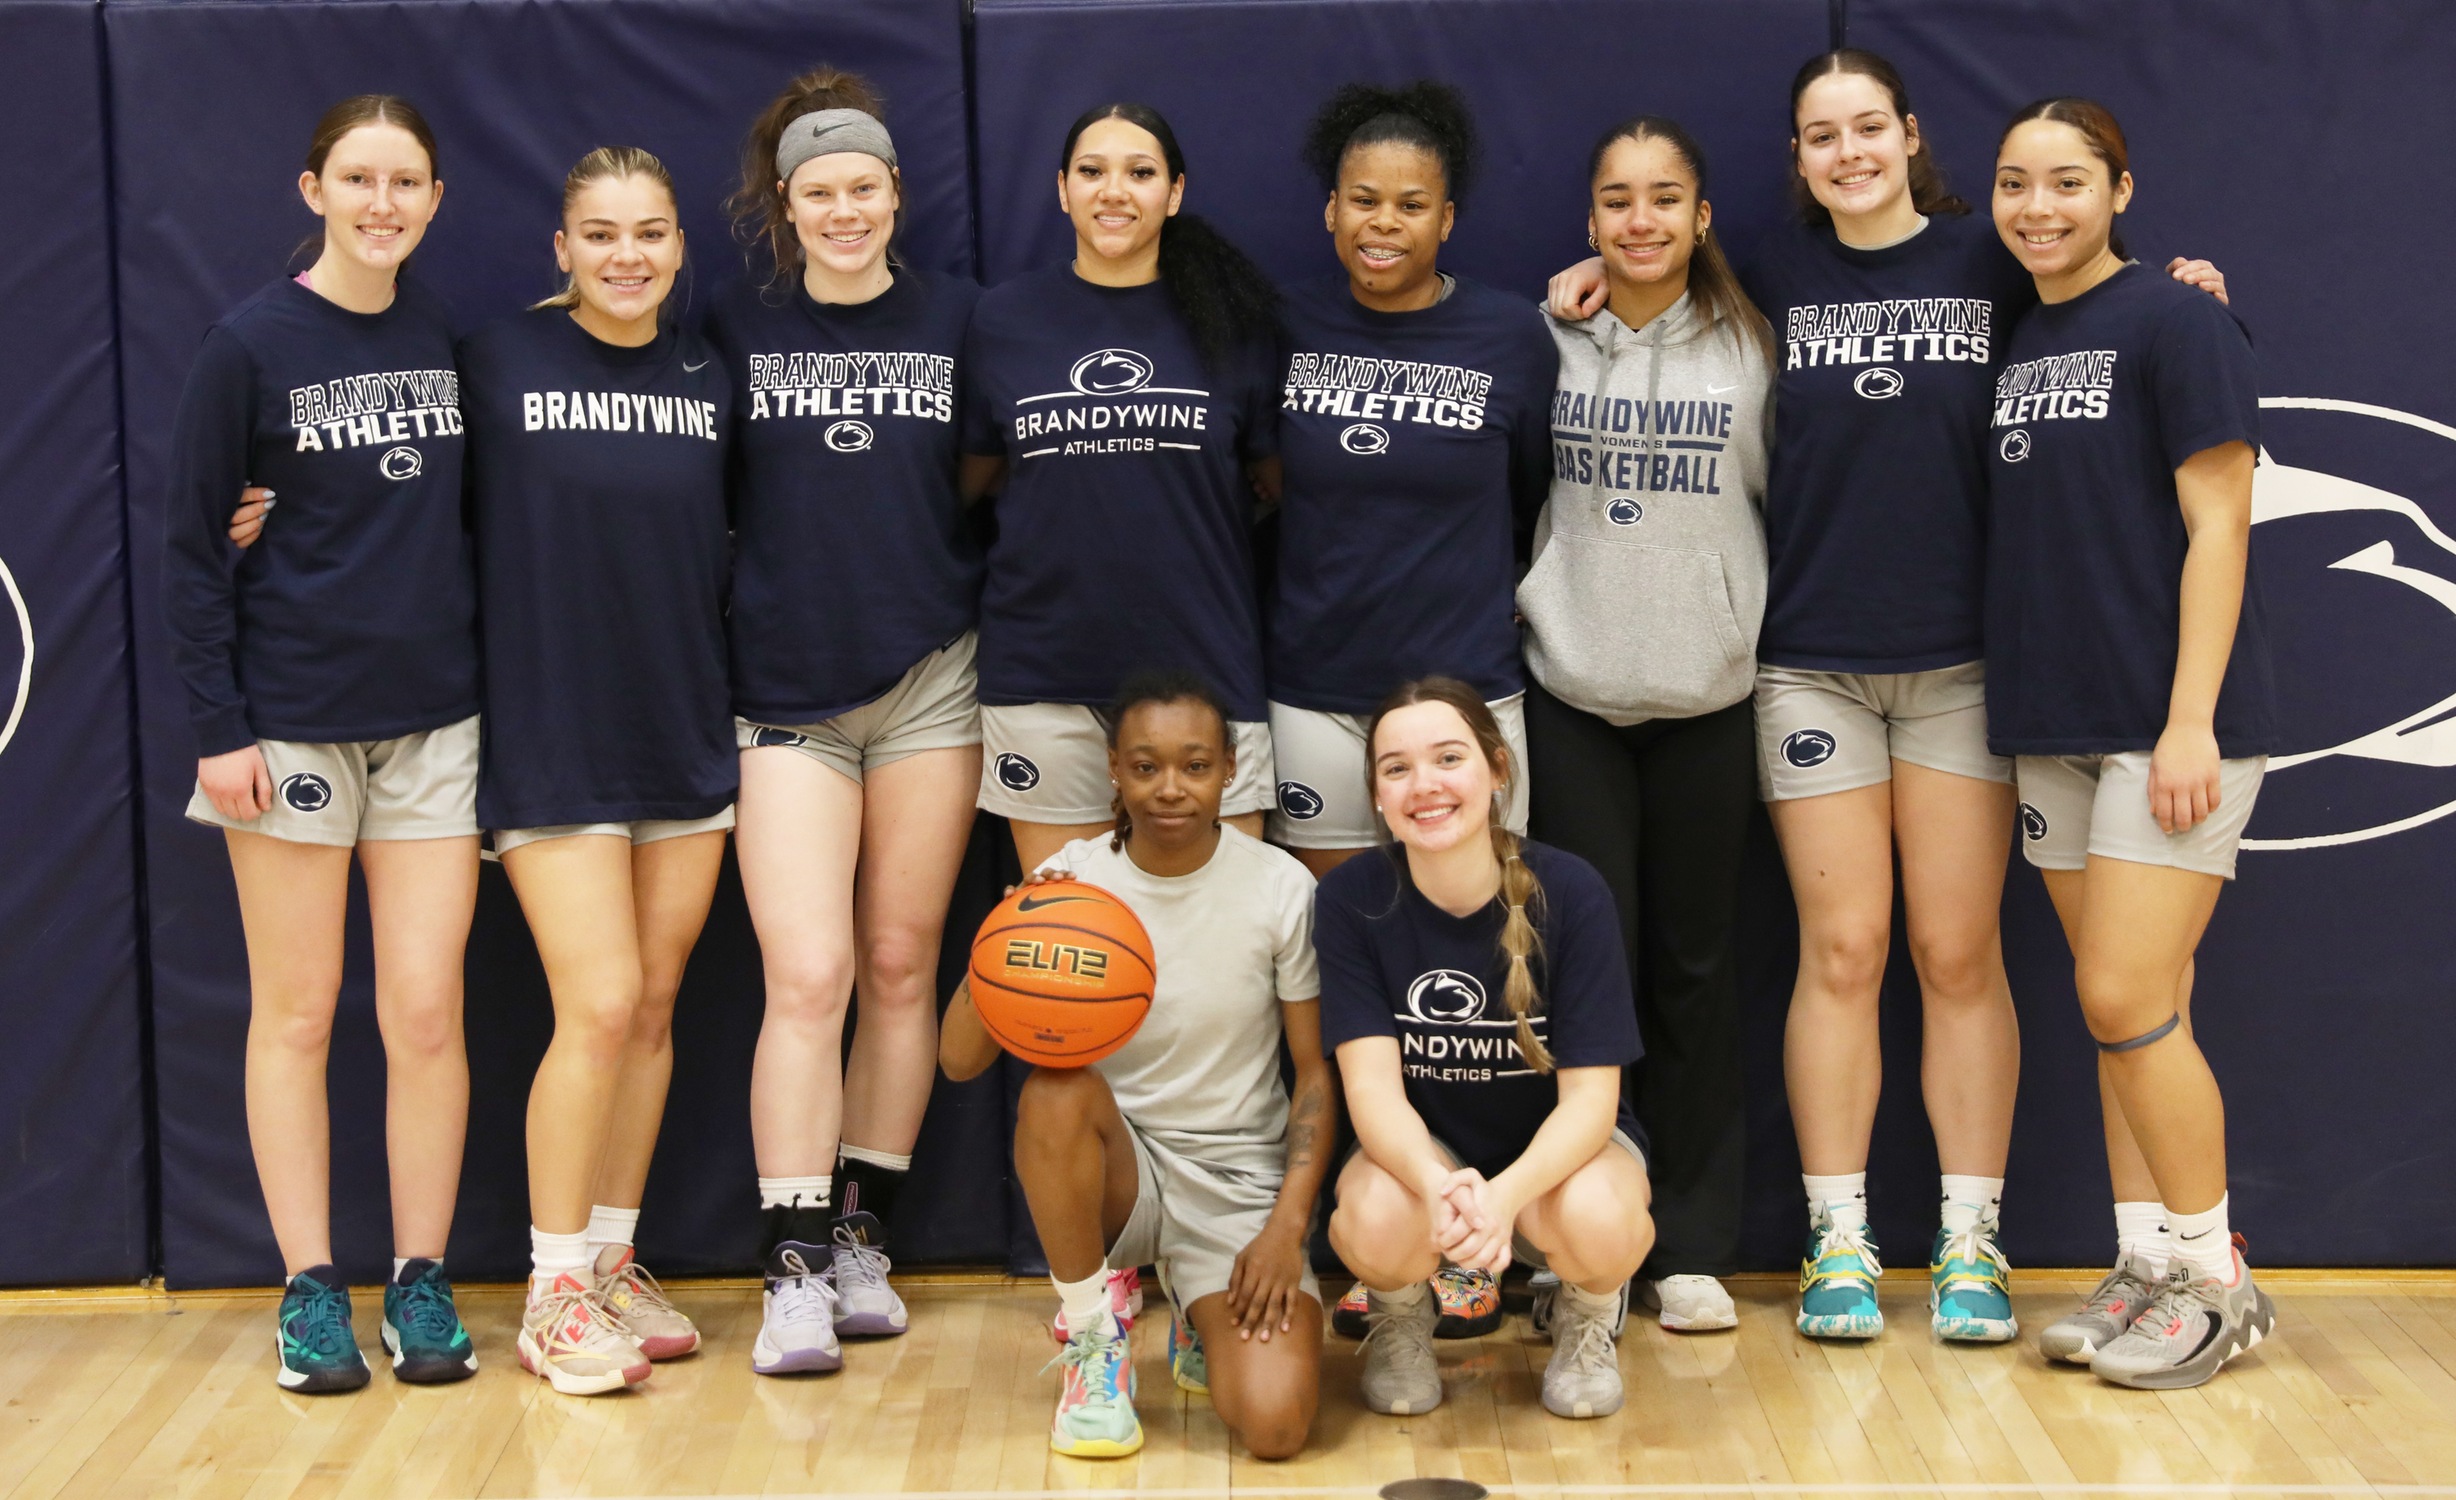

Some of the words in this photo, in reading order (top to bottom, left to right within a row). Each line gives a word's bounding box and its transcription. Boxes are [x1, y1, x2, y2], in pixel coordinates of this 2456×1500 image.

[1786, 298, 1992, 343] BRANDYWINE
[749, 352, 954, 395] BRANDYWINE
[1787, 333, 1990, 371] ATHLETICS
[290, 369, 459, 428] BRANDYWINE
[1285, 353, 1493, 407] BRANDYWINE
[523, 391, 718, 441] BRANDYWINE
[750, 387, 952, 423] ATHLETICS
[1015, 404, 1207, 440] BRANDYWINE
[1282, 388, 1484, 431] ATHLETICS
[295, 407, 464, 452] ATHLETIC
[1064, 438, 1154, 456] ATHLETICS
[1555, 443, 1720, 495] BASKETBALL
[1005, 939, 1109, 980] ELITE
[1404, 1032, 1548, 1060] NDYWIN
[1402, 1063, 1492, 1082] ATHLETICS
